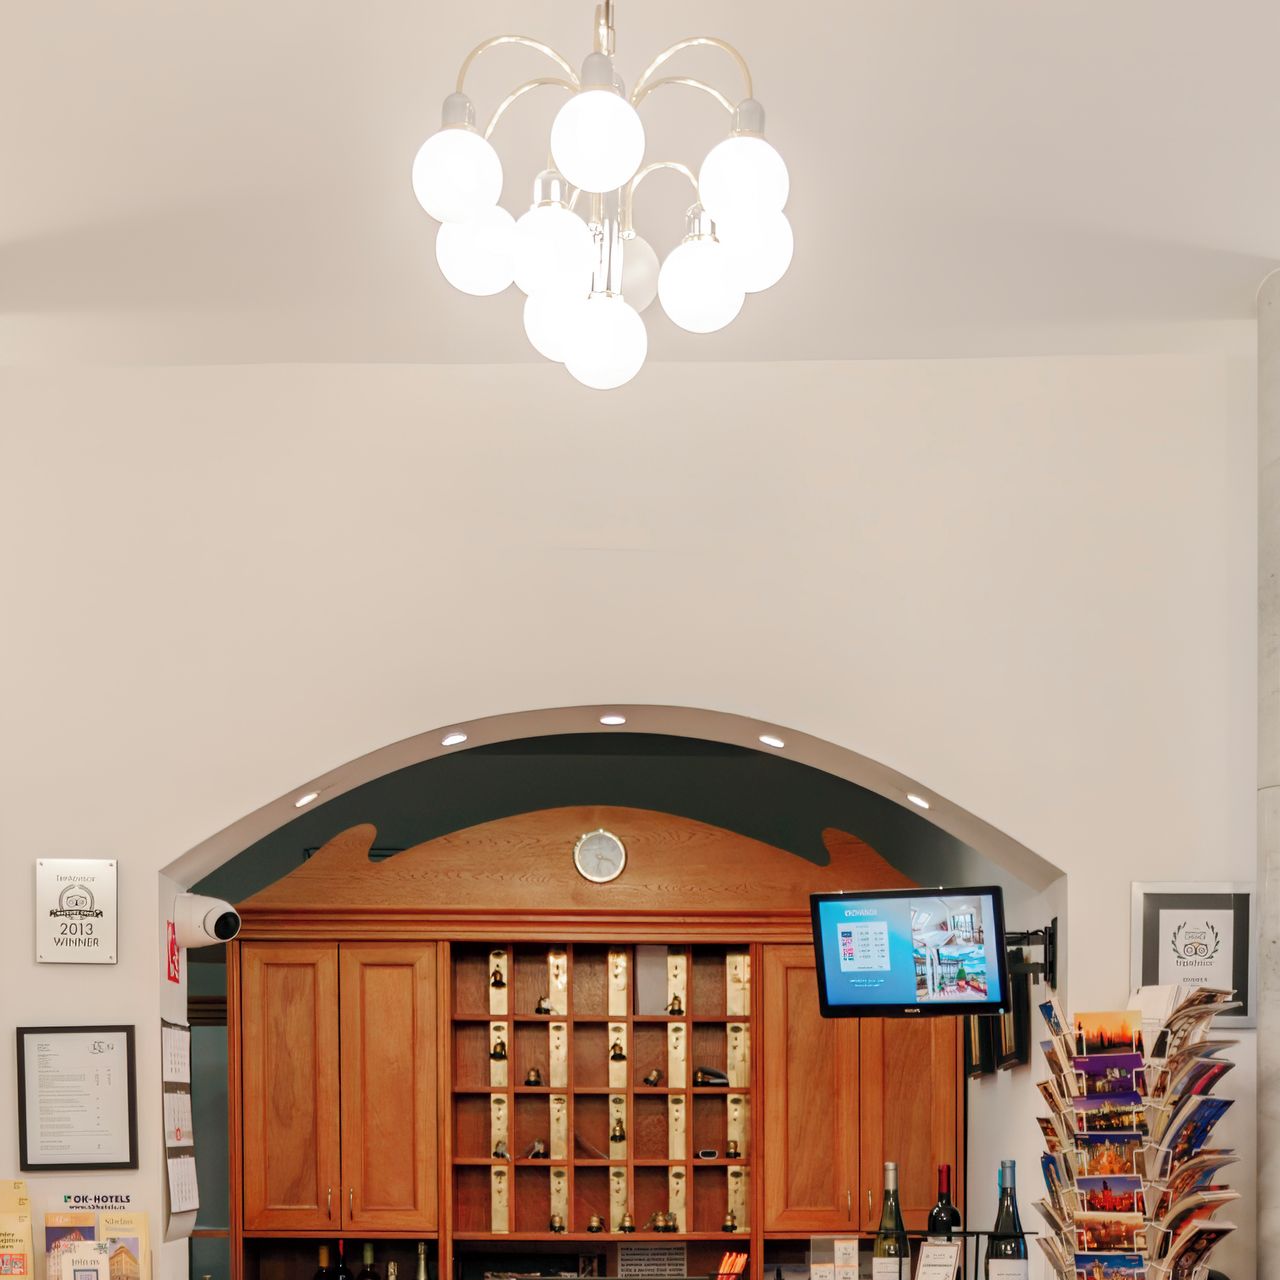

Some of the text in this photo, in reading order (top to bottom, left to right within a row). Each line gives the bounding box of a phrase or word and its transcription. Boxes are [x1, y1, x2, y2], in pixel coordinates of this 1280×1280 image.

[60, 922, 93, 935] 2013
[53, 937, 99, 947] WINNER
[73, 1194, 131, 1204] OK-HOTELS
